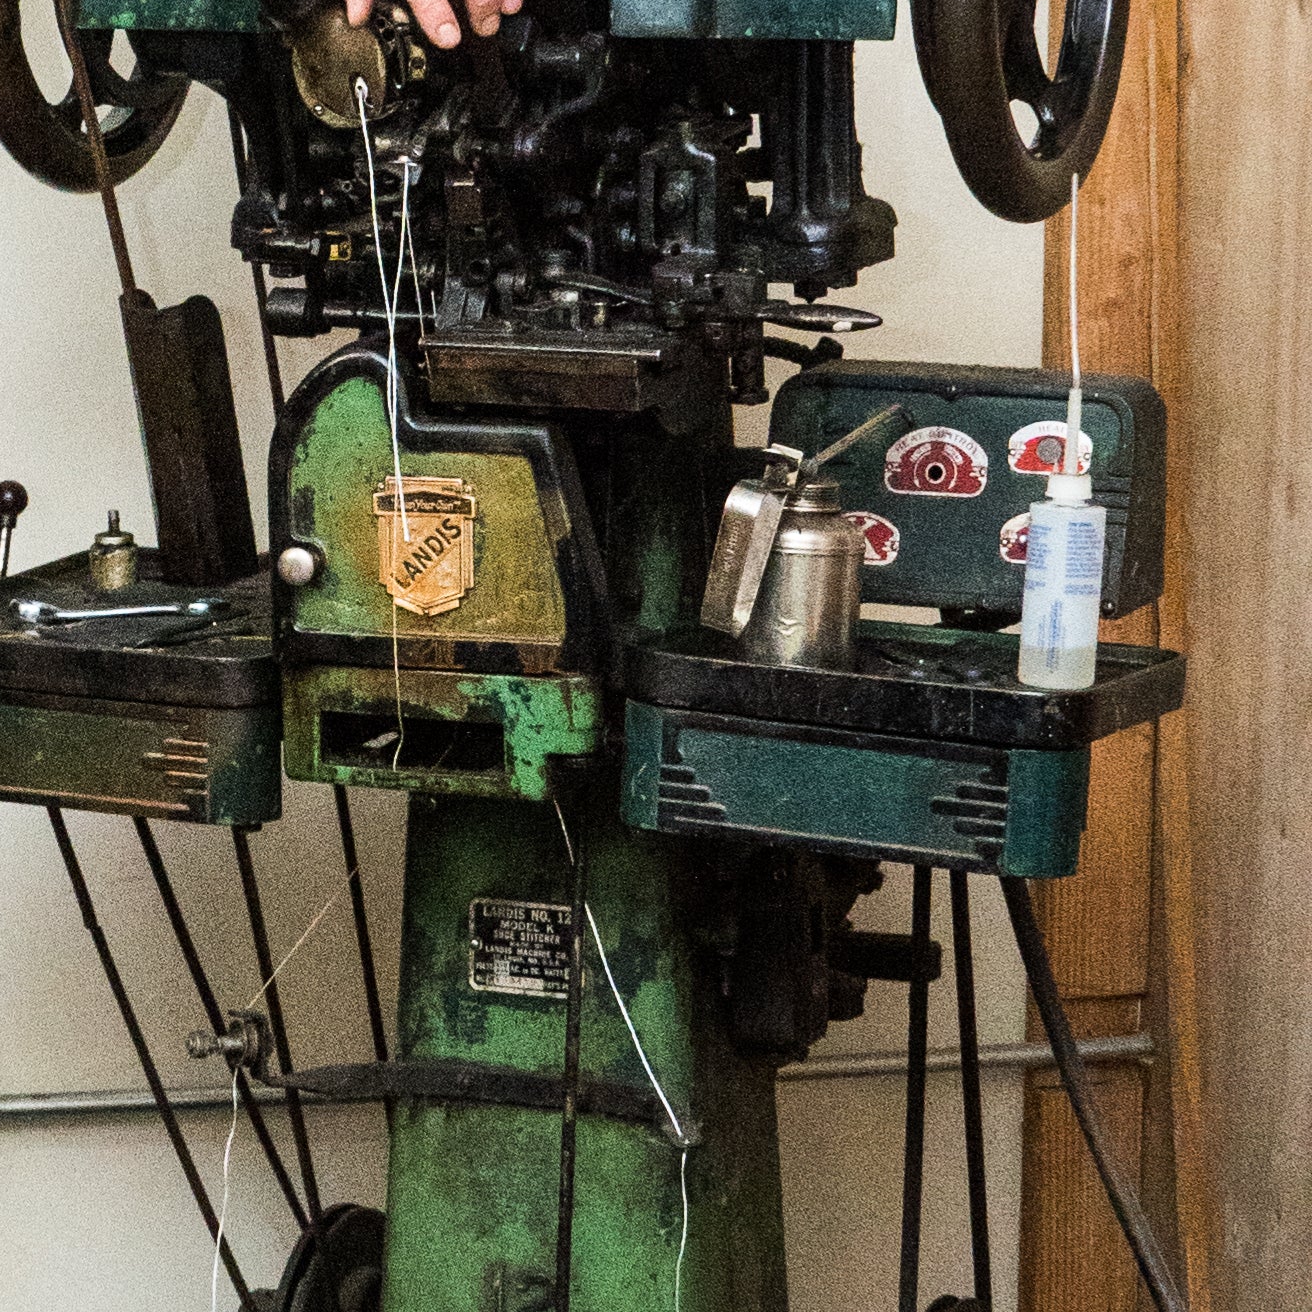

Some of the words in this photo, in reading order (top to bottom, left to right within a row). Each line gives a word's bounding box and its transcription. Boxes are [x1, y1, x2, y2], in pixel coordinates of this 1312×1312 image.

[389, 517, 462, 588] LANDIS
[500, 920, 541, 933] MODEL
[546, 924, 555, 934] K
[517, 948, 552, 958] MACHINE
